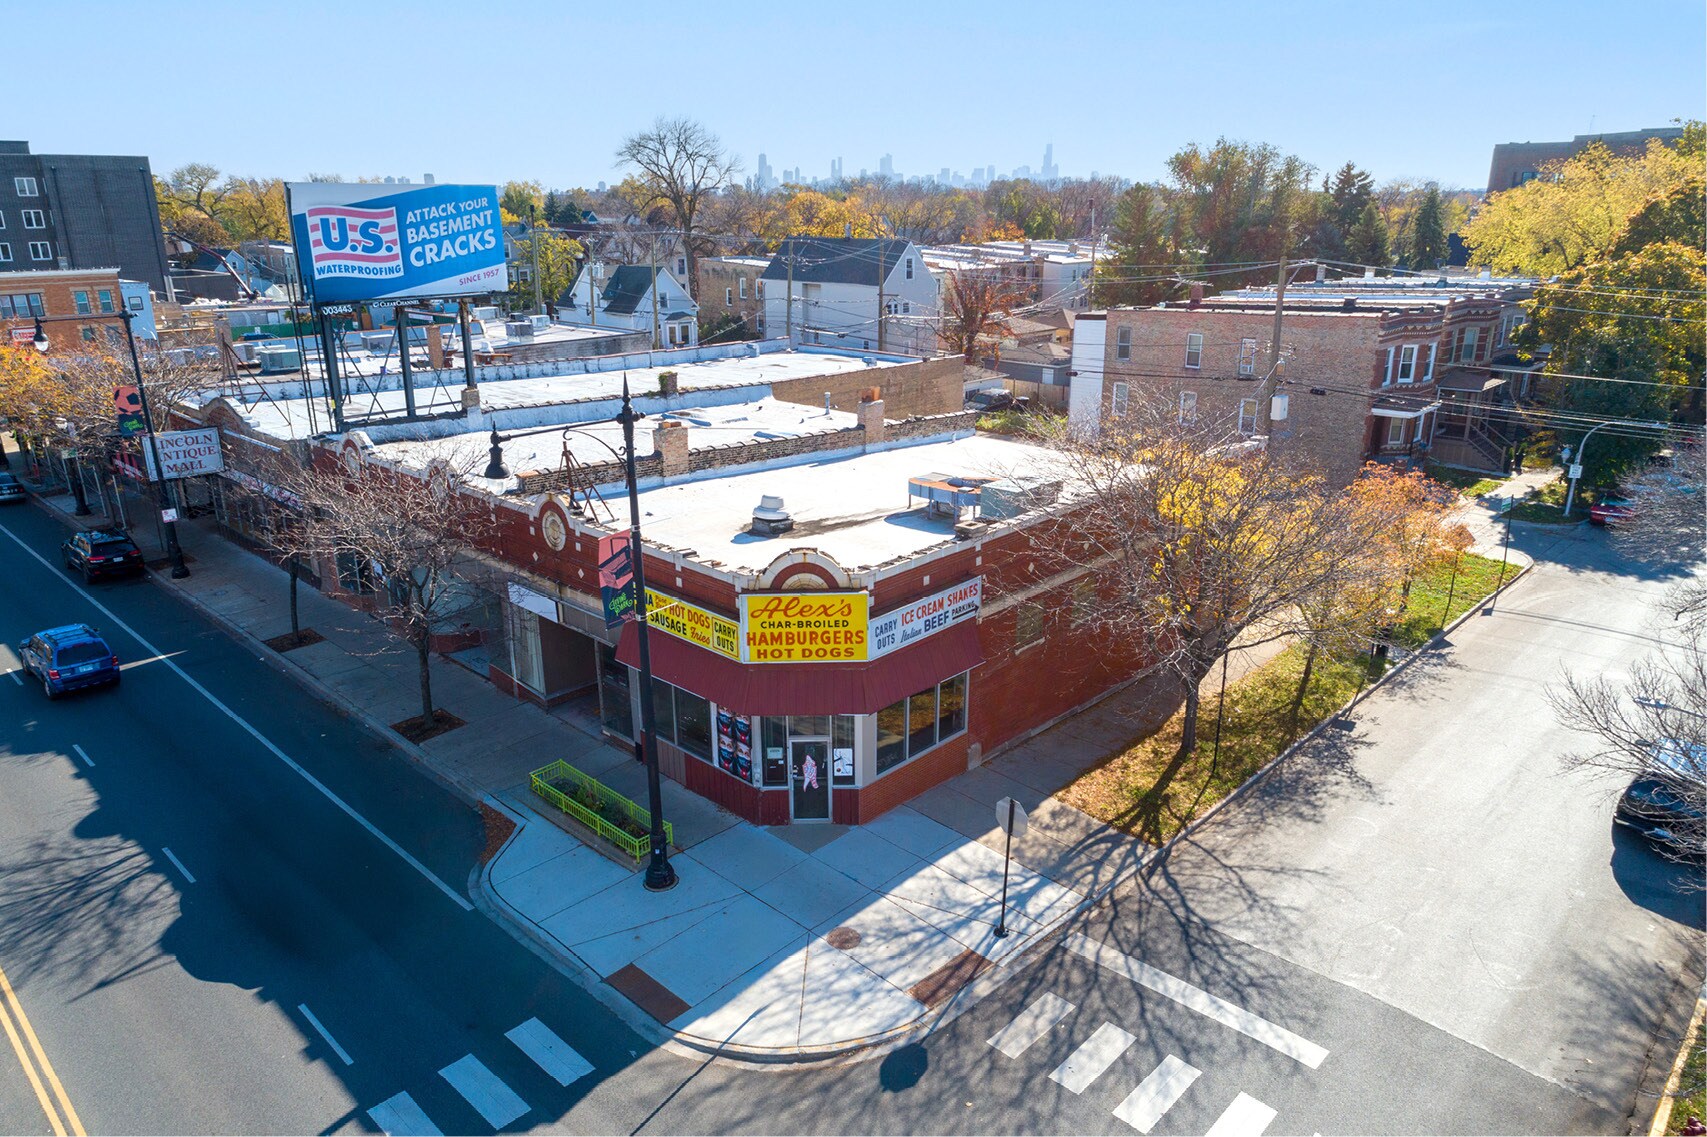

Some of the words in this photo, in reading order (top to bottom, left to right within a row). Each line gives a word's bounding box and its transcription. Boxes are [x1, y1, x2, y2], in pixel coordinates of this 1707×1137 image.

[406, 202, 457, 225] ATTACK
[459, 197, 489, 212] YOUR
[320, 217, 394, 254] U.S.
[407, 210, 493, 244] BASEMENT
[410, 228, 496, 267] CRACKS
[316, 264, 402, 276] WATERPROOFING
[459, 273, 481, 286] SINCE
[483, 269, 500, 279] 1957
[157, 433, 213, 450] INCOLN
[160, 446, 217, 462] NTIQUE
[165, 460, 207, 474] MALL
[750, 596, 852, 619] Alex's
[901, 609, 914, 626] ICE
[916, 597, 944, 621] CREAM
[947, 583, 979, 607] SHAKES
[669, 603, 686, 619] HOT
[687, 609, 711, 629] DOGS
[760, 619, 849, 629] CHAR-BROILED
[900, 627, 922, 643] Italian
[924, 610, 950, 633] BEEF
[951, 600, 975, 617] PARKING
[650, 611, 687, 635] SAUSAGE
[690, 626, 711, 645] Fries
[714, 621, 736, 639] CARRY
[875, 618, 898, 638] CARRY
[716, 635, 734, 652] OUTS
[746, 630, 865, 646] HAMBURGERS
[877, 633, 896, 650] OUTS
[757, 648, 794, 659] HOT
[801, 647, 855, 658] DOGS
